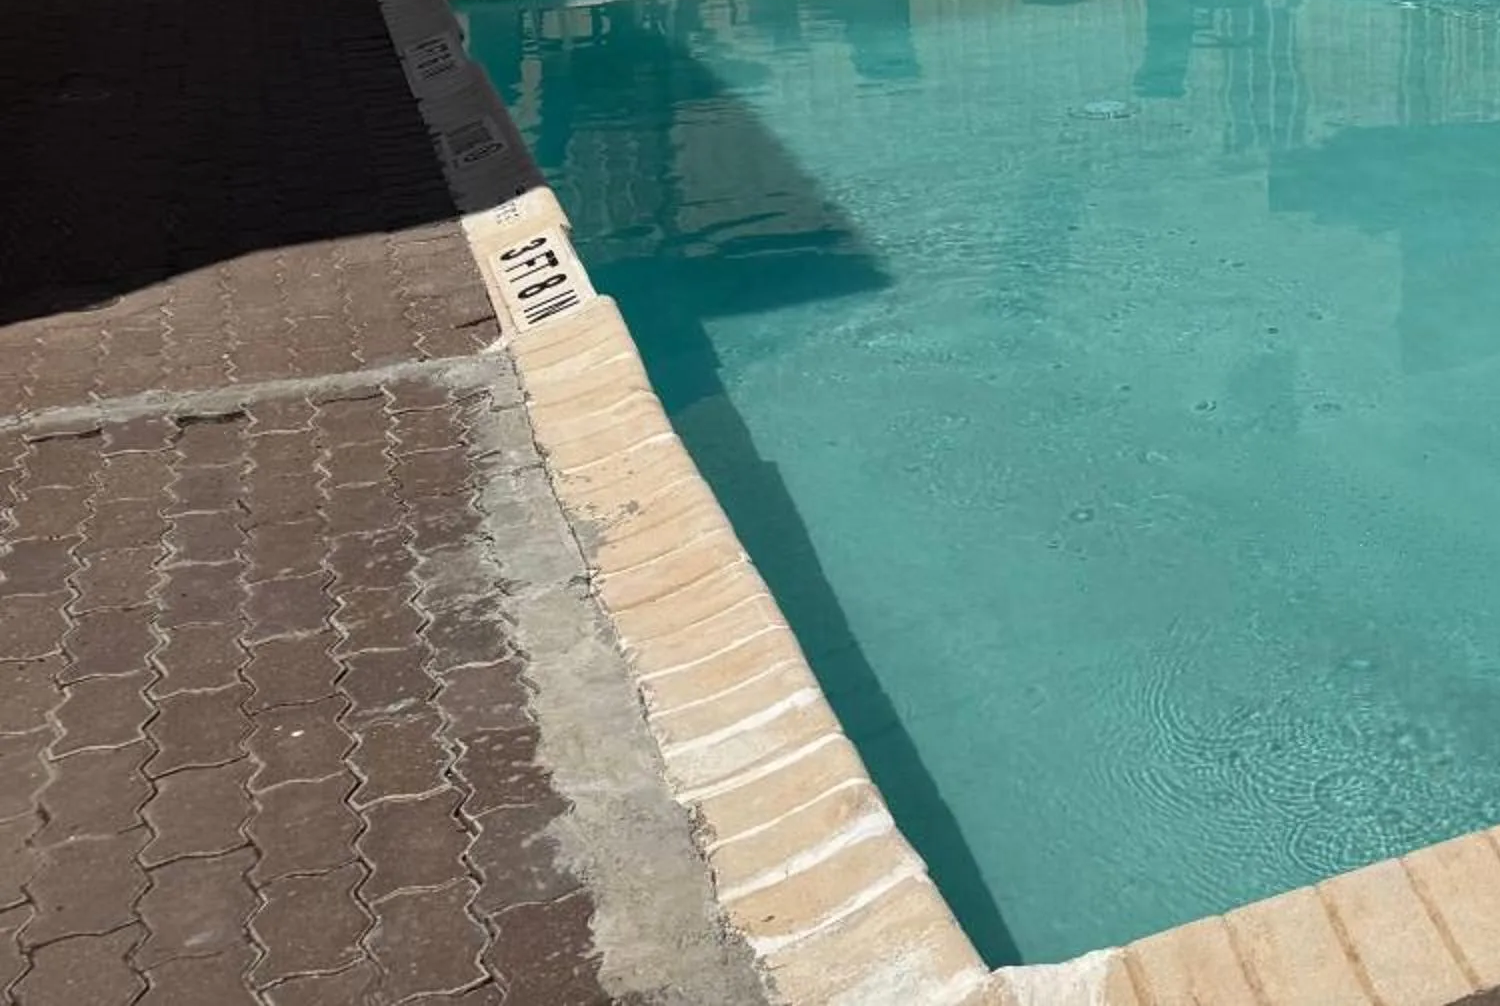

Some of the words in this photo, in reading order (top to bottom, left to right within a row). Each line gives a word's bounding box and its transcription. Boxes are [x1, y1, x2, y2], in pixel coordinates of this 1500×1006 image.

[500, 237, 547, 261] 3
[504, 249, 559, 283] FT
[517, 273, 567, 300] 8
[523, 289, 580, 325] IN
